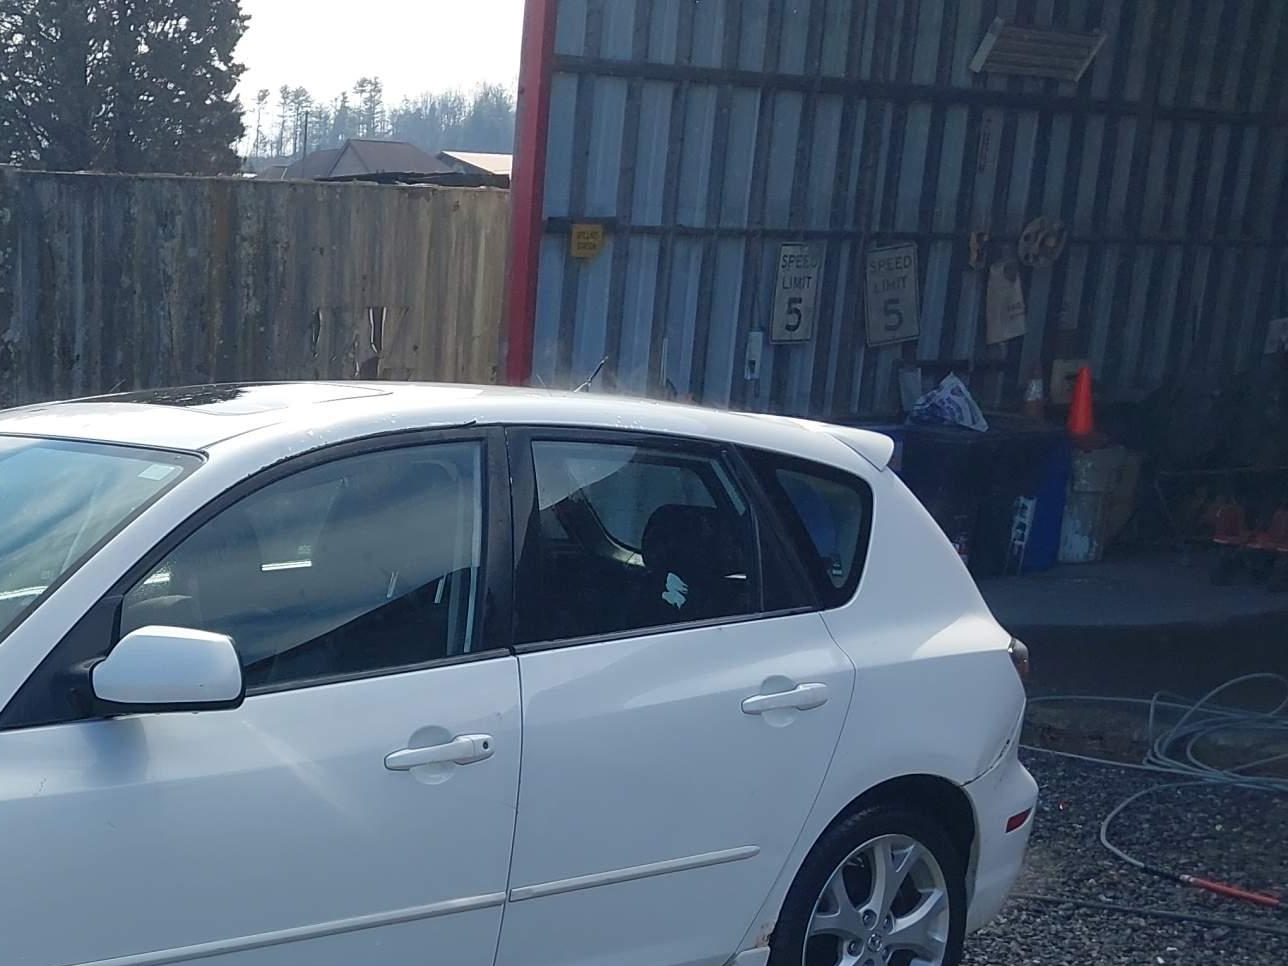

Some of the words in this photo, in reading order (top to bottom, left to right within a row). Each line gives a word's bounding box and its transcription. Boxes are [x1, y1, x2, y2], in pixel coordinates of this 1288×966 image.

[781, 254, 819, 269] SPEED
[869, 255, 911, 273] SPEED
[781, 275, 813, 291] LIMIT
[873, 275, 908, 294] LIMIT
[784, 297, 803, 332] 5
[883, 298, 904, 331] 5
